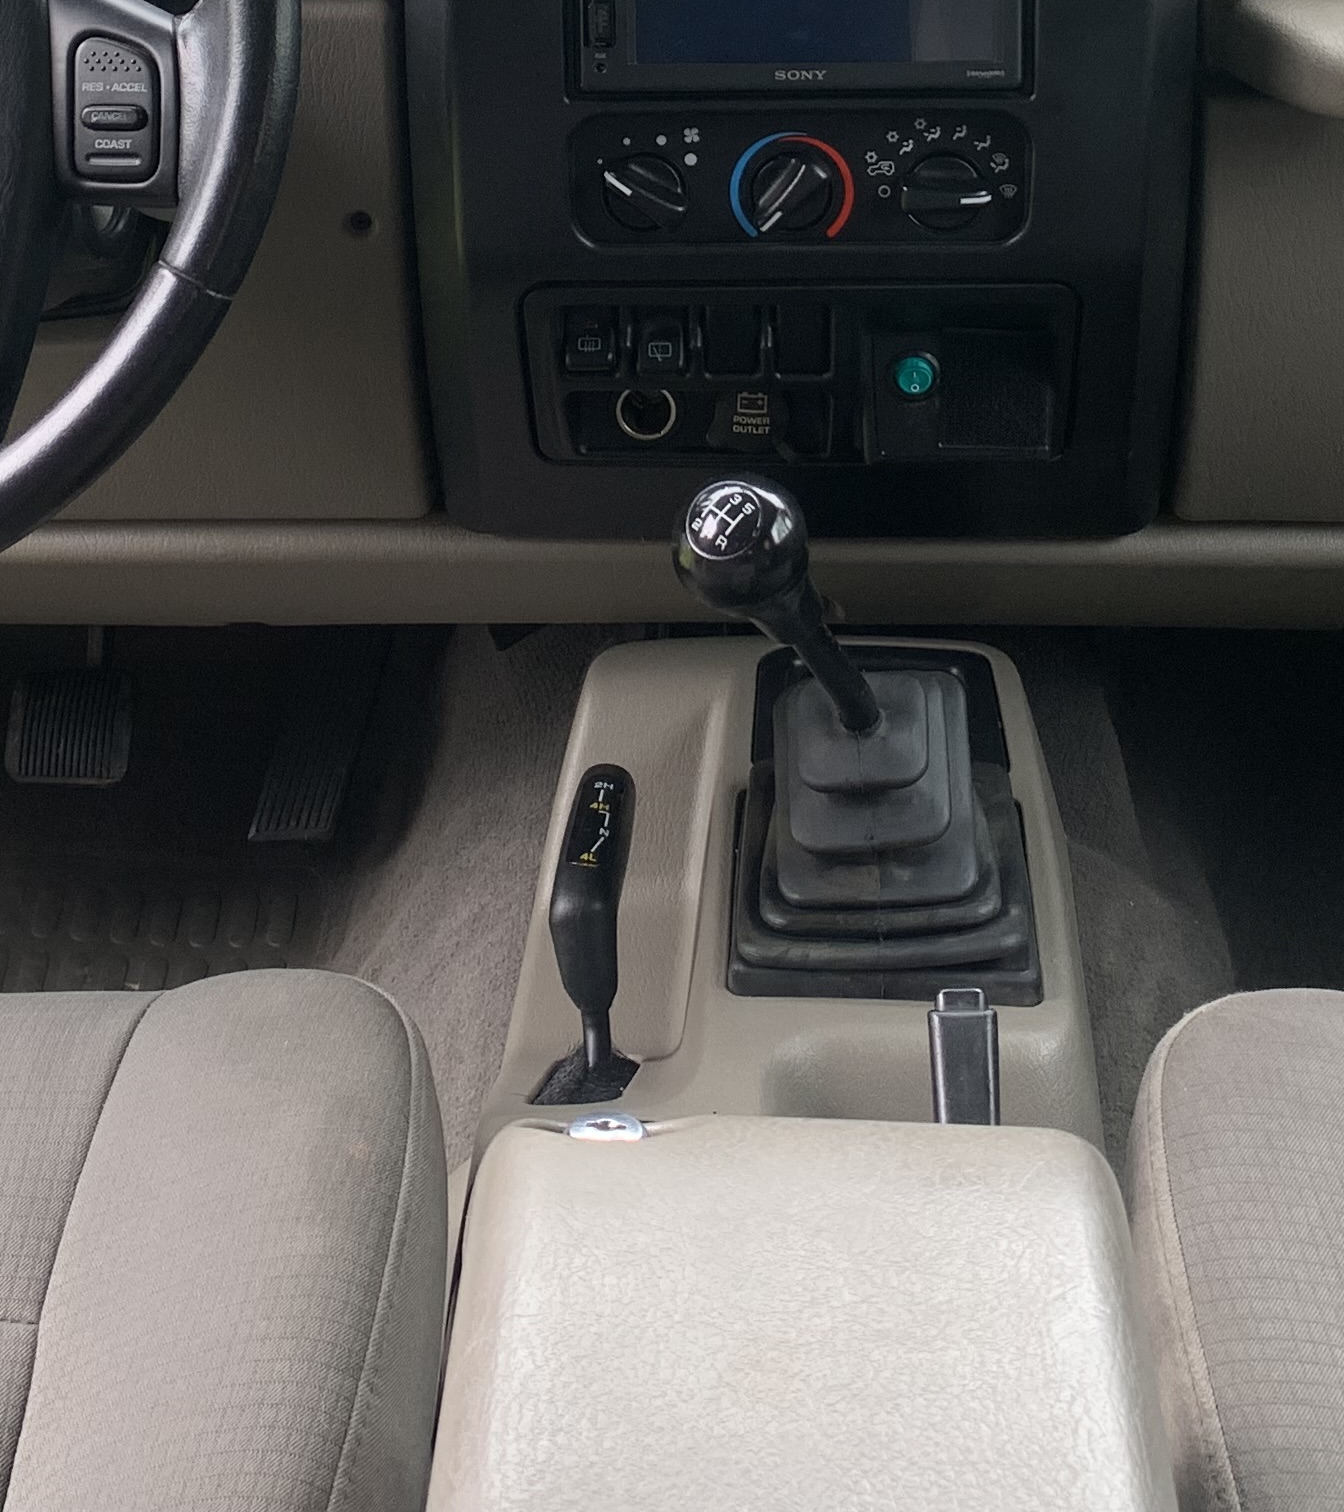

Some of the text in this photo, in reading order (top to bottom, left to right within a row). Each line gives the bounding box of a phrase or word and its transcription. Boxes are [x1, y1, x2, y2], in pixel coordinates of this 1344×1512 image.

[774, 70, 827, 81] SONY
[94, 139, 133, 149] COAST
[732, 415, 770, 425] POWER
[732, 424, 771, 435] OUTLET
[729, 493, 743, 506] 3
[742, 502, 756, 515] 5
[691, 517, 703, 531] 2
[715, 534, 728, 551] R
[594, 781, 614, 790] 2H
[589, 802, 610, 811] 4H
[599, 827, 610, 837] N
[579, 852, 597, 862] 4L
